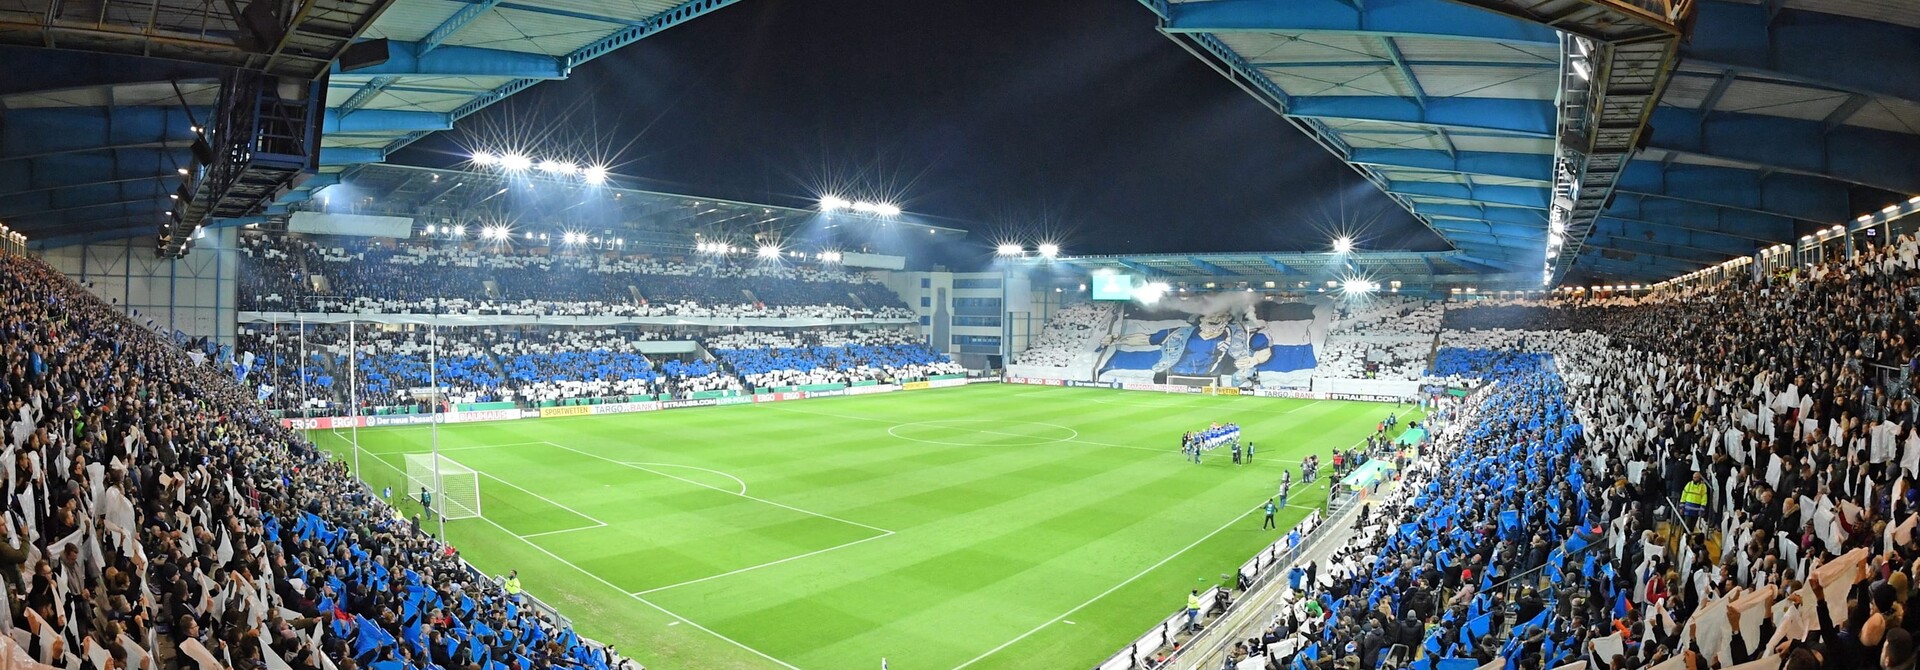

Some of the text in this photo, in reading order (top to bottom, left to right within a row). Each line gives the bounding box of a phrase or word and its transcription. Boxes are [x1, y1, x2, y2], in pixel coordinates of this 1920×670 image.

[757, 393, 775, 402] ERGO
[783, 392, 800, 400] ERGO
[459, 409, 507, 421] BAUHAUS
[521, 409, 540, 418] bwin
[544, 407, 588, 416] SPORTWETTEN
[377, 417, 389, 425] Der
[391, 417, 408, 425] neue
